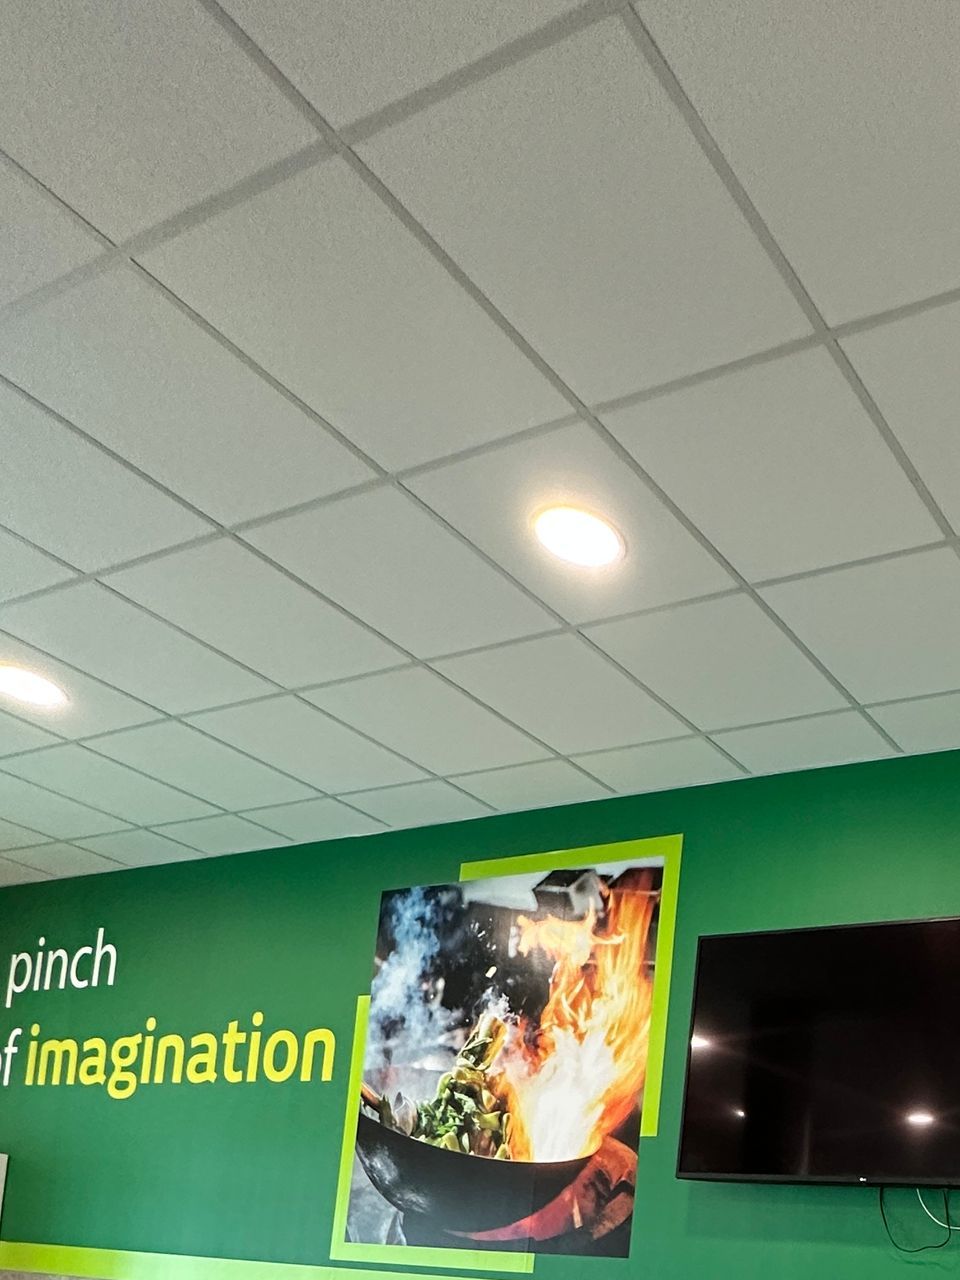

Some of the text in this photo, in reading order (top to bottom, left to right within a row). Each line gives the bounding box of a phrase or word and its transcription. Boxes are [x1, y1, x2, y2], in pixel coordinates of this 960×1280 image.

[5, 927, 118, 1008] pinch
[0, 1011, 336, 1099] f imagination
